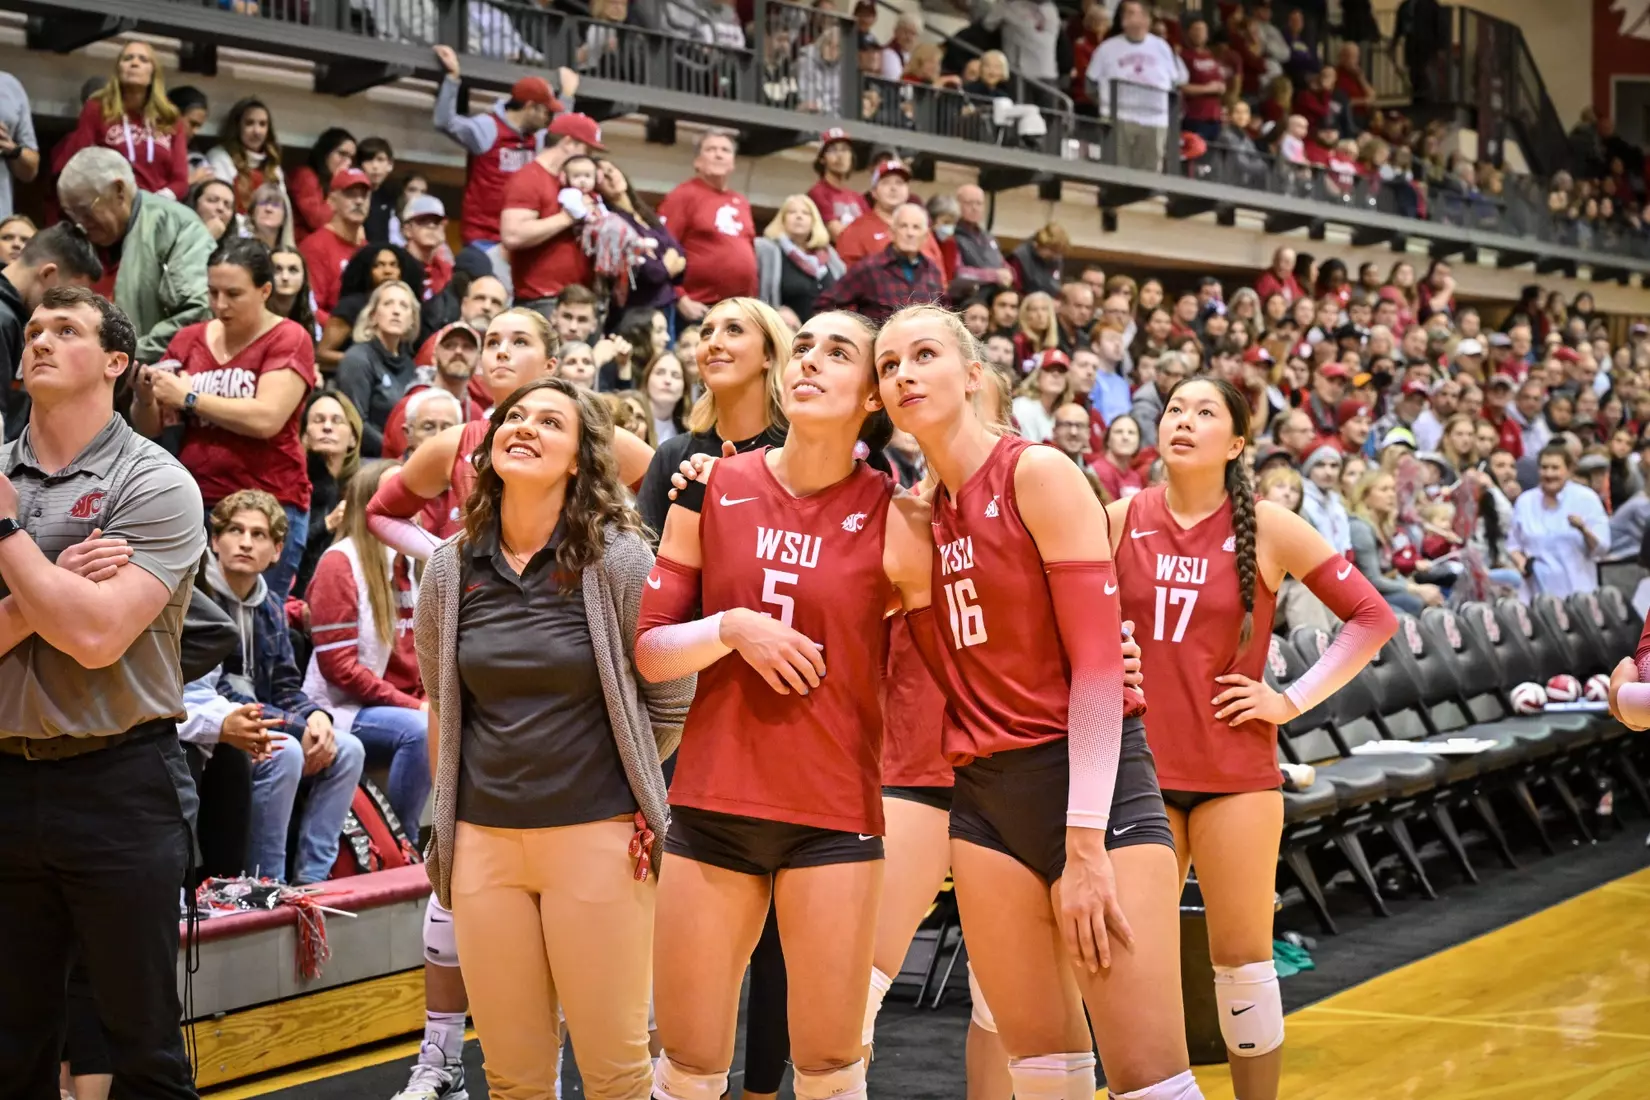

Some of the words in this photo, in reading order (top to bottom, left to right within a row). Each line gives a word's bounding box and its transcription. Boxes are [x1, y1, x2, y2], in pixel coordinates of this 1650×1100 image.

[192, 367, 256, 398] OUGARS
[756, 526, 822, 569] WSU
[937, 536, 974, 576] WSU
[1156, 553, 1209, 585] WSU
[760, 567, 800, 629] 5
[943, 577, 988, 650] 16
[1153, 585, 1199, 643] 17
